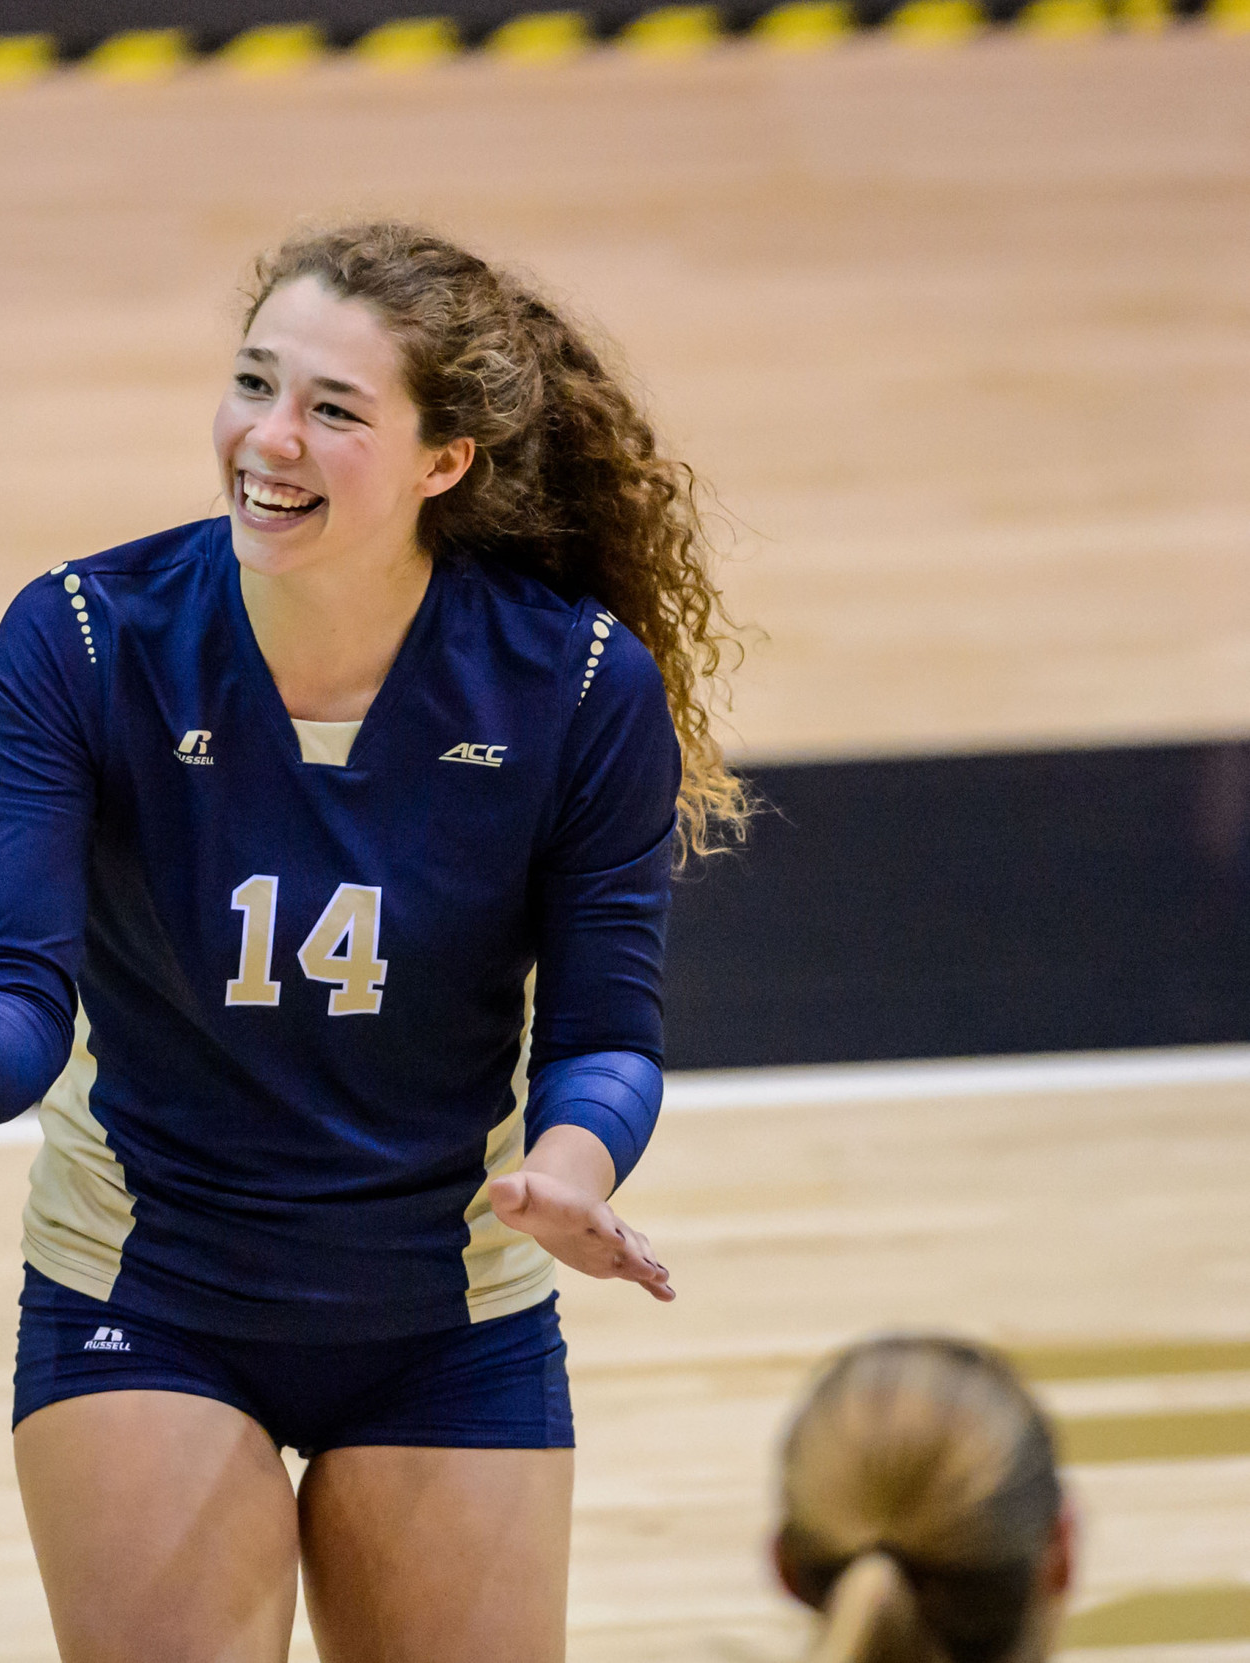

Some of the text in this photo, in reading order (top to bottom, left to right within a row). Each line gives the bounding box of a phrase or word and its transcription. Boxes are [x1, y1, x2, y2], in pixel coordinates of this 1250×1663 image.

[443, 742, 508, 763] ACC
[225, 874, 388, 1016] 14
[83, 1340, 131, 1351] RUSSELL
